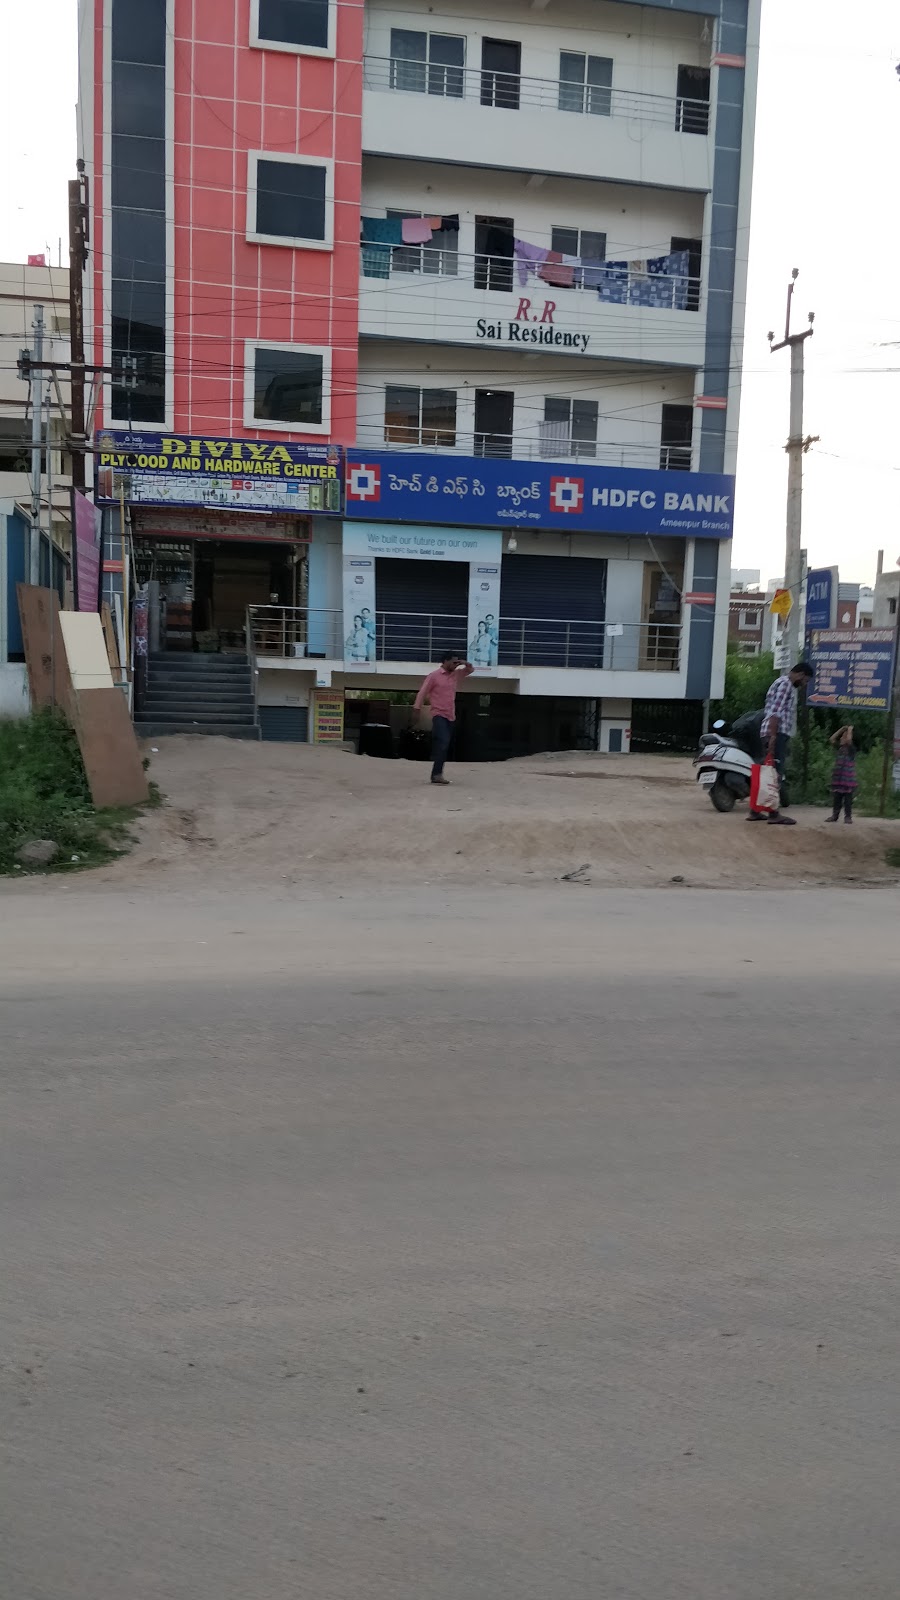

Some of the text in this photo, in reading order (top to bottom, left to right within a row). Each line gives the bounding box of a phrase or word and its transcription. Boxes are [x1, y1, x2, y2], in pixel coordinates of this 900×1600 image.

[515, 297, 556, 323] R.R
[476, 319, 590, 352] Sai Residency
[161, 438, 293, 462] DIVIYA
[172, 456, 201, 471] AND
[205, 458, 280, 476] HARDWARE
[284, 463, 337, 478] CENTER
[388, 473, 541, 505] హెచ్ డి ఎఫ్ సి బ్యాంక్
[592, 487, 730, 514] HDFC BANK
[660, 517, 729, 530] Ameenpur Branch
[367, 534, 379, 543] We
[381, 535, 398, 544] built
[414, 536, 436, 546] future
[437, 539, 447, 547] on
[808, 581, 828, 602] ATM
